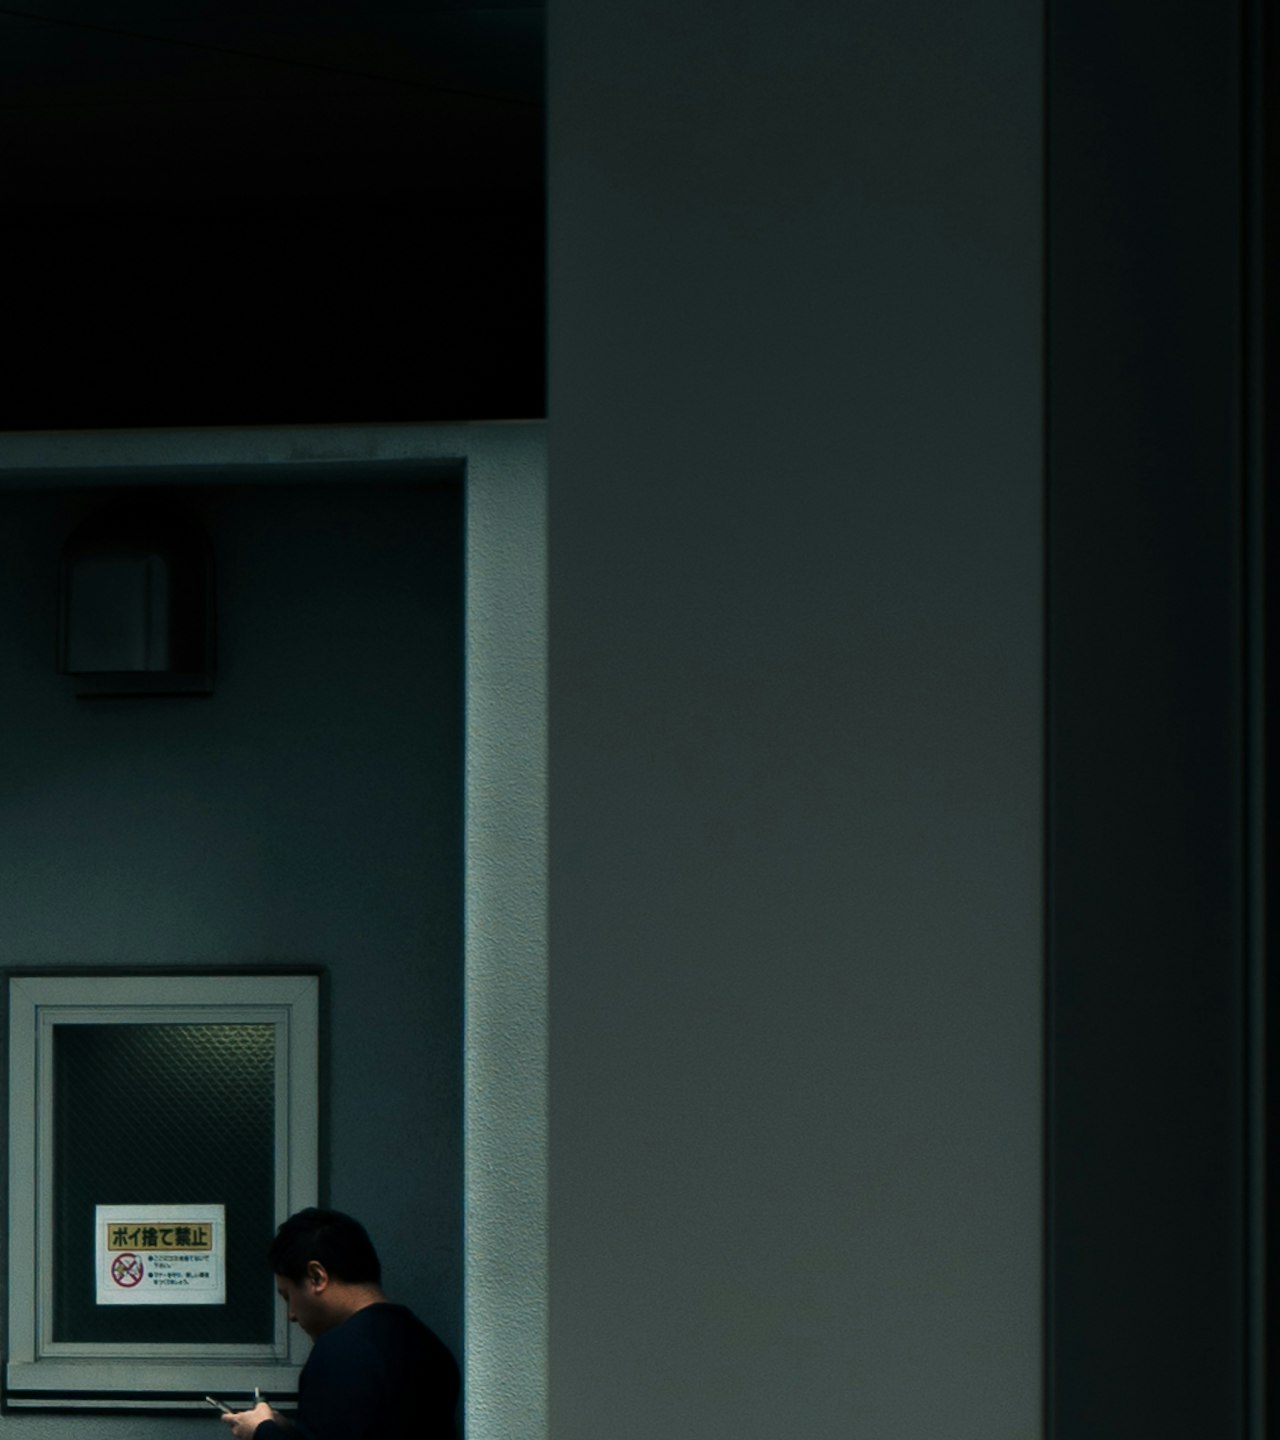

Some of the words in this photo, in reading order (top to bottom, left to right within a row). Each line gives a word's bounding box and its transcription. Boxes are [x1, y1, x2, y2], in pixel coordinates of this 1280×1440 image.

[113, 1227, 207, 1247] ポイ捨て禁止
